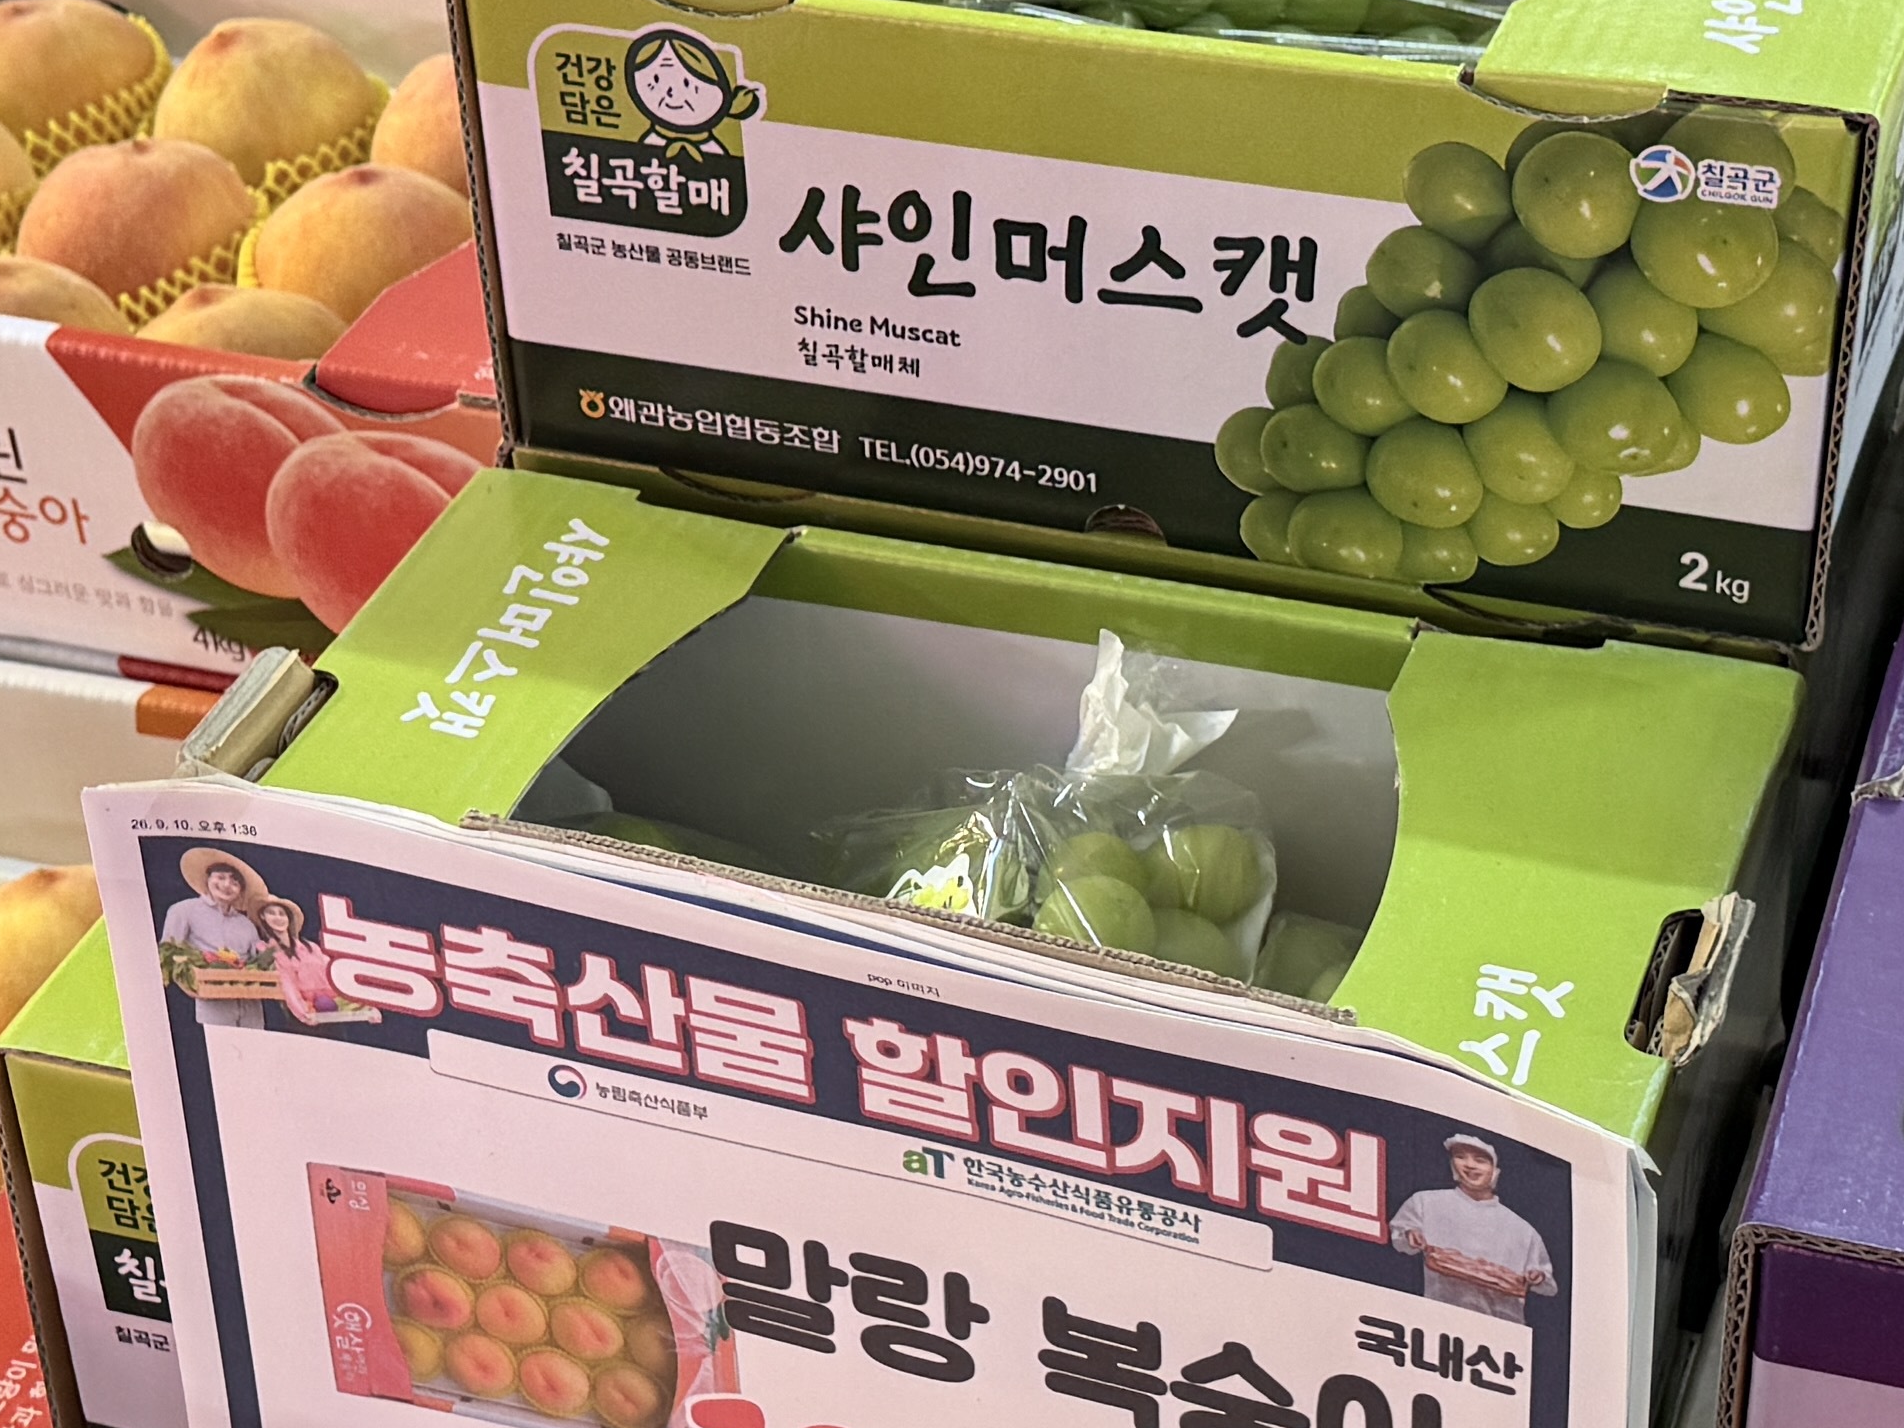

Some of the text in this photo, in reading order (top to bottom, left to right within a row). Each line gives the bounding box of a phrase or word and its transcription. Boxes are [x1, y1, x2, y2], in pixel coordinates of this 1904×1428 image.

[552, 49, 619, 95] 건강
[558, 87, 621, 135] 담은
[558, 147, 731, 218] 칠곡할매
[1696, 158, 1779, 194] 칠곡군
[556, 232, 752, 280] 칠곡군 농산물 공동브랜드
[781, 184, 1318, 347] 샤인머스캣
[793, 304, 962, 350] Shine Muscat
[796, 337, 922, 379] 칠곡할매체
[611, 390, 839, 458] 왜관농업협동조합
[193, 627, 247, 661] 4kg
[397, 517, 612, 743] 샤인머스캣
[317, 891, 1388, 1247] 농축산물 할인지원
[903, 1147, 1202, 1233] aT 한국농수산식품유통공사
[710, 1220, 990, 1384] 말랑
[116, 1324, 170, 1352] 칠곡군
[1355, 1315, 1523, 1397] 국내산
